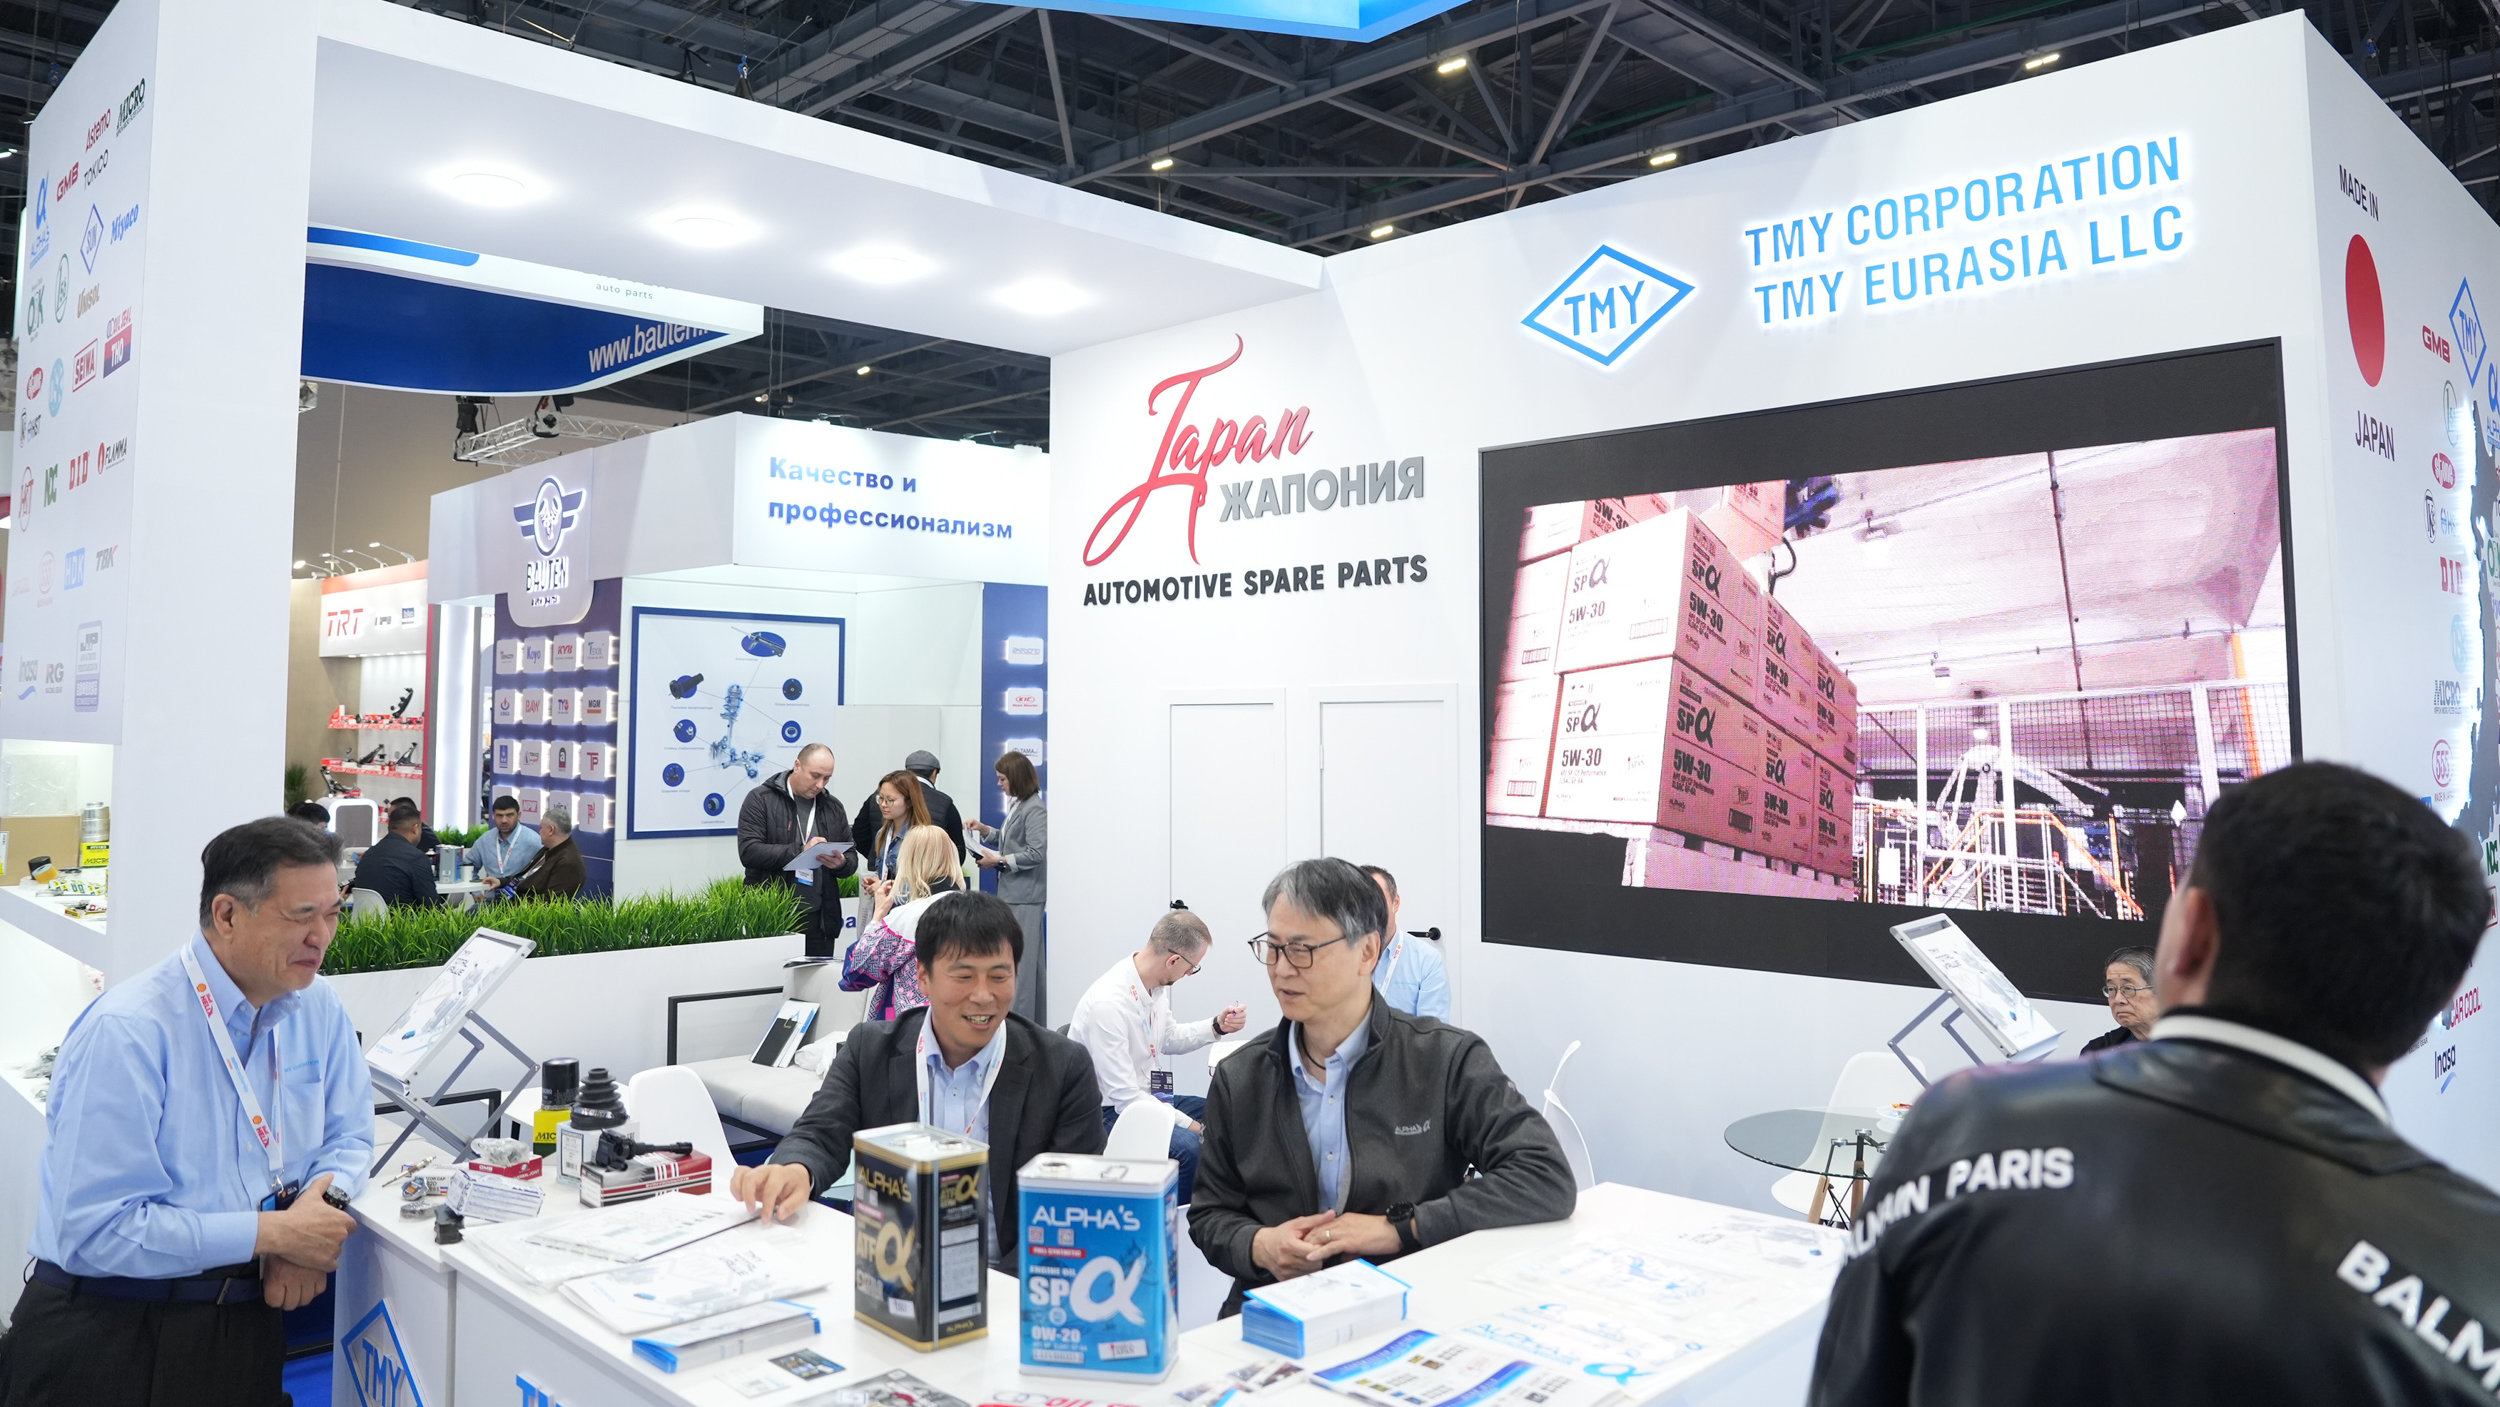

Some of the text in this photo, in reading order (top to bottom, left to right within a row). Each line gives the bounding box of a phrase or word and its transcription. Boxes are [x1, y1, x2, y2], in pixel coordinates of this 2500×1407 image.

[117, 77, 146, 129] MICRO
[86, 108, 111, 152] Astemo
[56, 161, 79, 202] GMB
[84, 149, 109, 190] TOKICO
[1745, 136, 2180, 267] TMY CORPORATION
[2339, 164, 2379, 222] MADE IN
[110, 203, 139, 245] Miyaco
[1754, 205, 2184, 324] TMY EURASIA LLC
[596, 282, 653, 300] auto parts
[1564, 280, 1645, 337] TMY
[589, 322, 709, 373] www.bauten.
[2422, 325, 2451, 363] GMB
[2459, 309, 2478, 359] TMY
[75, 348, 95, 385] SEIWA
[104, 437, 127, 466] FLAMMA
[1082, 332, 1314, 566] Japan
[2355, 410, 2395, 462] JAPAN
[769, 456, 917, 493] Качество и
[1219, 455, 1425, 522] ЖАПОНИЯ
[768, 501, 1013, 539] профессионализм
[96, 545, 118, 571] TBK
[526, 556, 569, 593] BAUTEN
[1083, 554, 1428, 606] AUTOMOTIVE SPARE PARTS
[328, 608, 364, 637] TRT
[1569, 601, 1605, 624] 5W-30
[1689, 592, 1724, 632] 5W-30
[1765, 657, 1789, 687] 5W-30
[2433, 680, 2462, 707] MICRO
[1561, 748, 1602, 767] 5W-30
[1673, 749, 1711, 784] 5W-30
[2435, 750, 2451, 780] 555
[1764, 791, 1788, 816] 5W-30
[200, 995, 214, 1018] HELIX
[2434, 1044, 2456, 1080] Inasa
[256, 1127, 270, 1149] HELIX
[859, 1165, 912, 1204] ALPHA'S
[1946, 1147, 2075, 1200] PARIS
[1032, 1204, 1141, 1231] ALPHA'S
[1029, 1265, 1060, 1275] ENGINE
[1031, 1326, 1081, 1343] 0W-20
[2336, 1239, 2500, 1402] BALM
[361, 1336, 403, 1407] TMY
